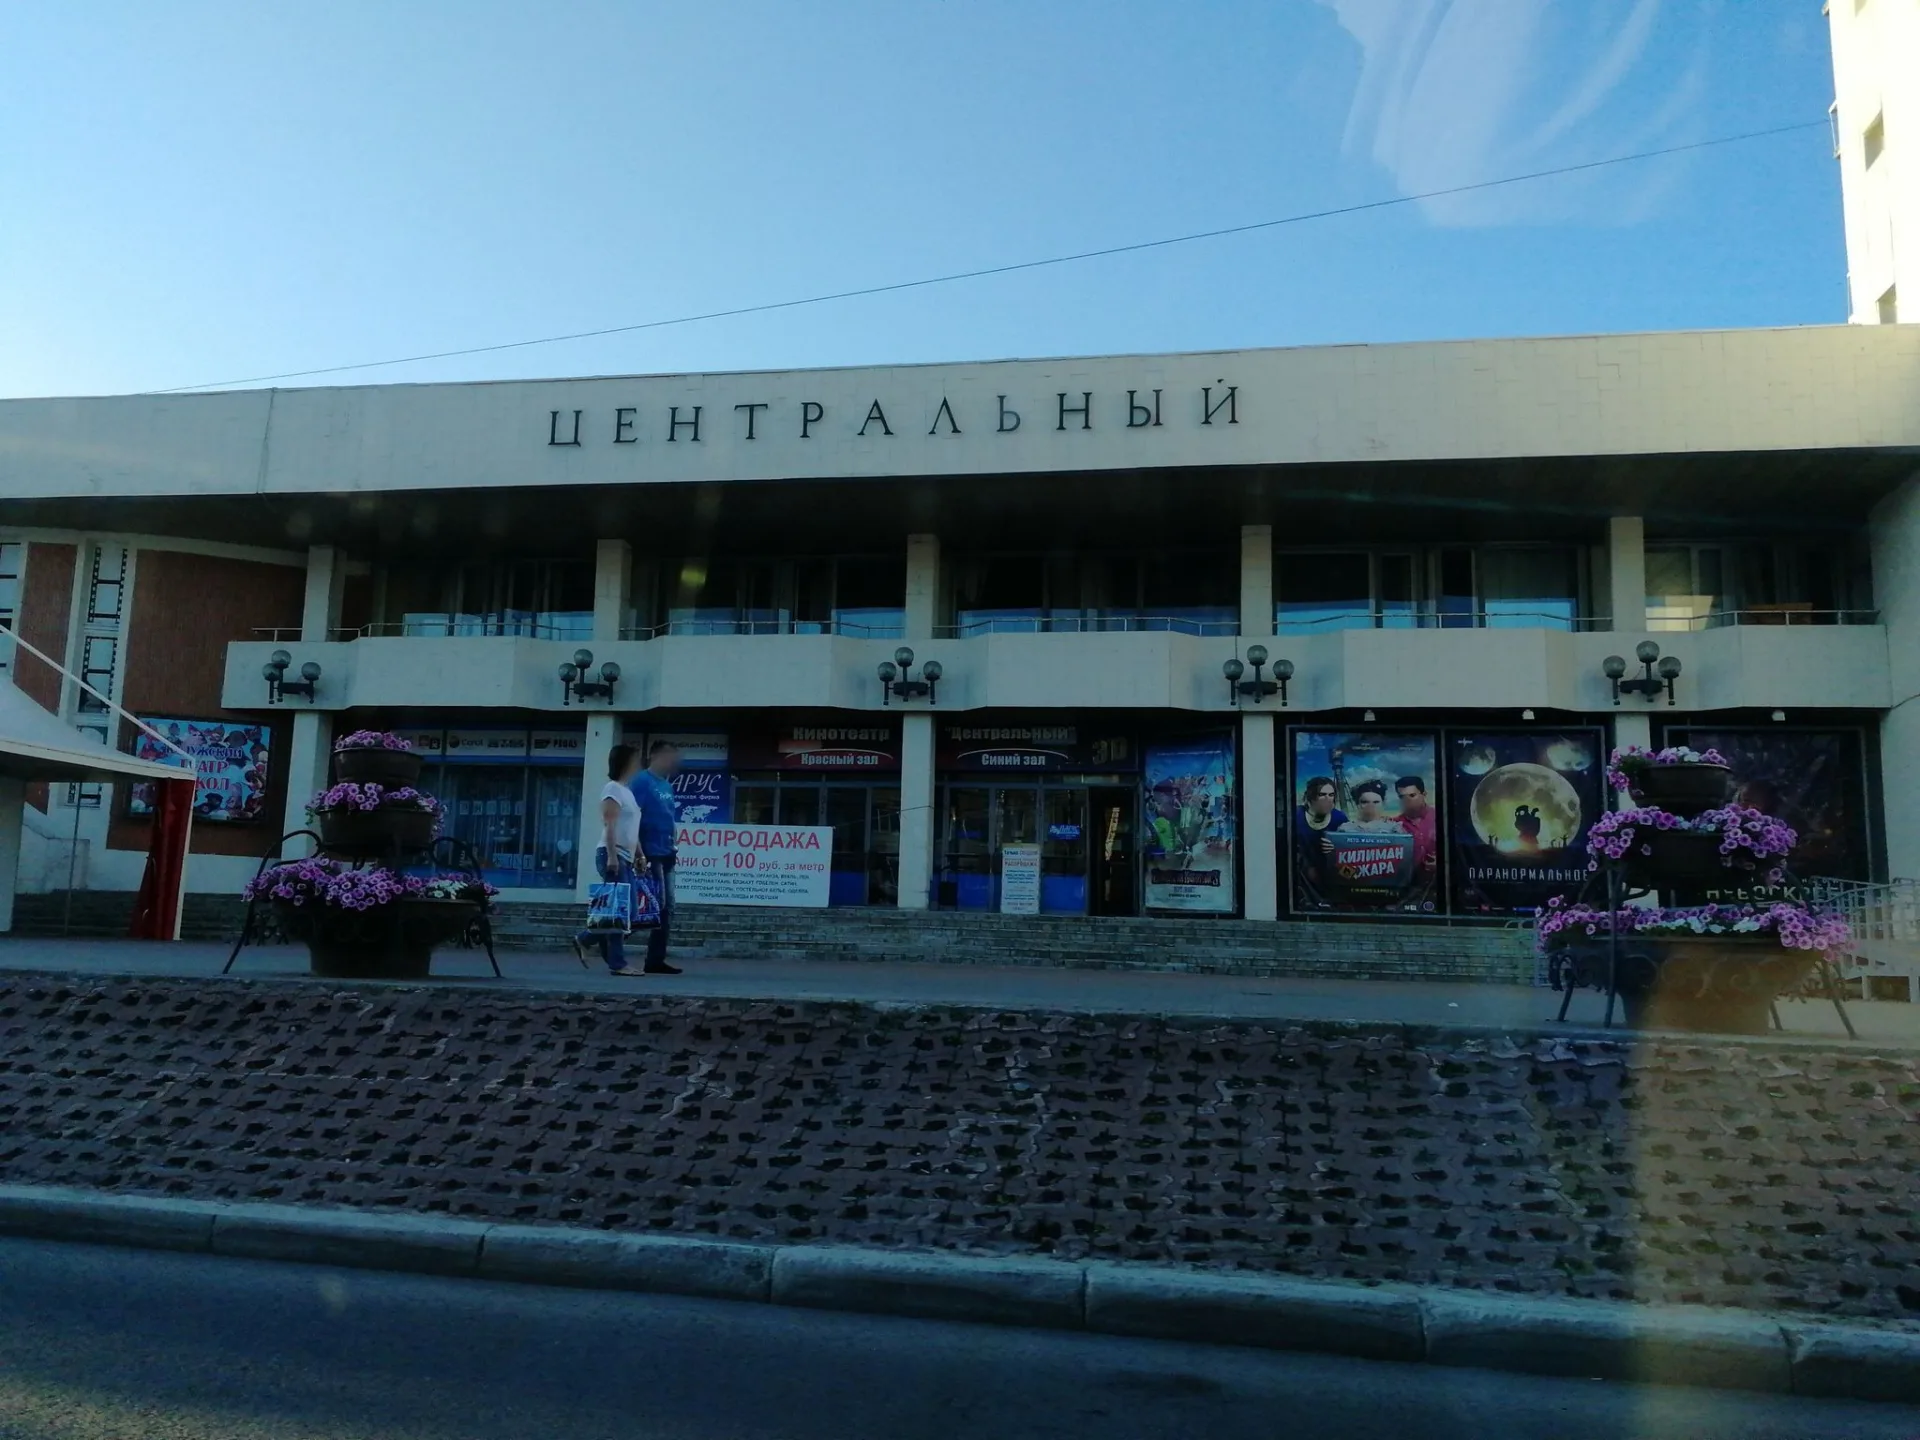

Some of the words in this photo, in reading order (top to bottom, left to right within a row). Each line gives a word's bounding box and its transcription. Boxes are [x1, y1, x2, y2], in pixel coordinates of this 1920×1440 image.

[548, 378, 1240, 447] ЦЕНТРАЛЬНЫЙ
[793, 727, 890, 742] Кинотеатр
[801, 753, 854, 766] Красный
[857, 755, 878, 765] зал
[981, 753, 1021, 766] Синий
[1023, 755, 1046, 766] зал
[669, 773, 722, 793] АРУС
[676, 829, 821, 851] АСПРОДАЖА
[723, 852, 755, 869] 100
[759, 860, 780, 872] руб.
[784, 862, 796, 871] за
[799, 863, 825, 873] метр
[1338, 846, 1404, 864] КИЛИМАН
[1469, 867, 1588, 881] ПАРАНОРМАЛЬНОЕ
